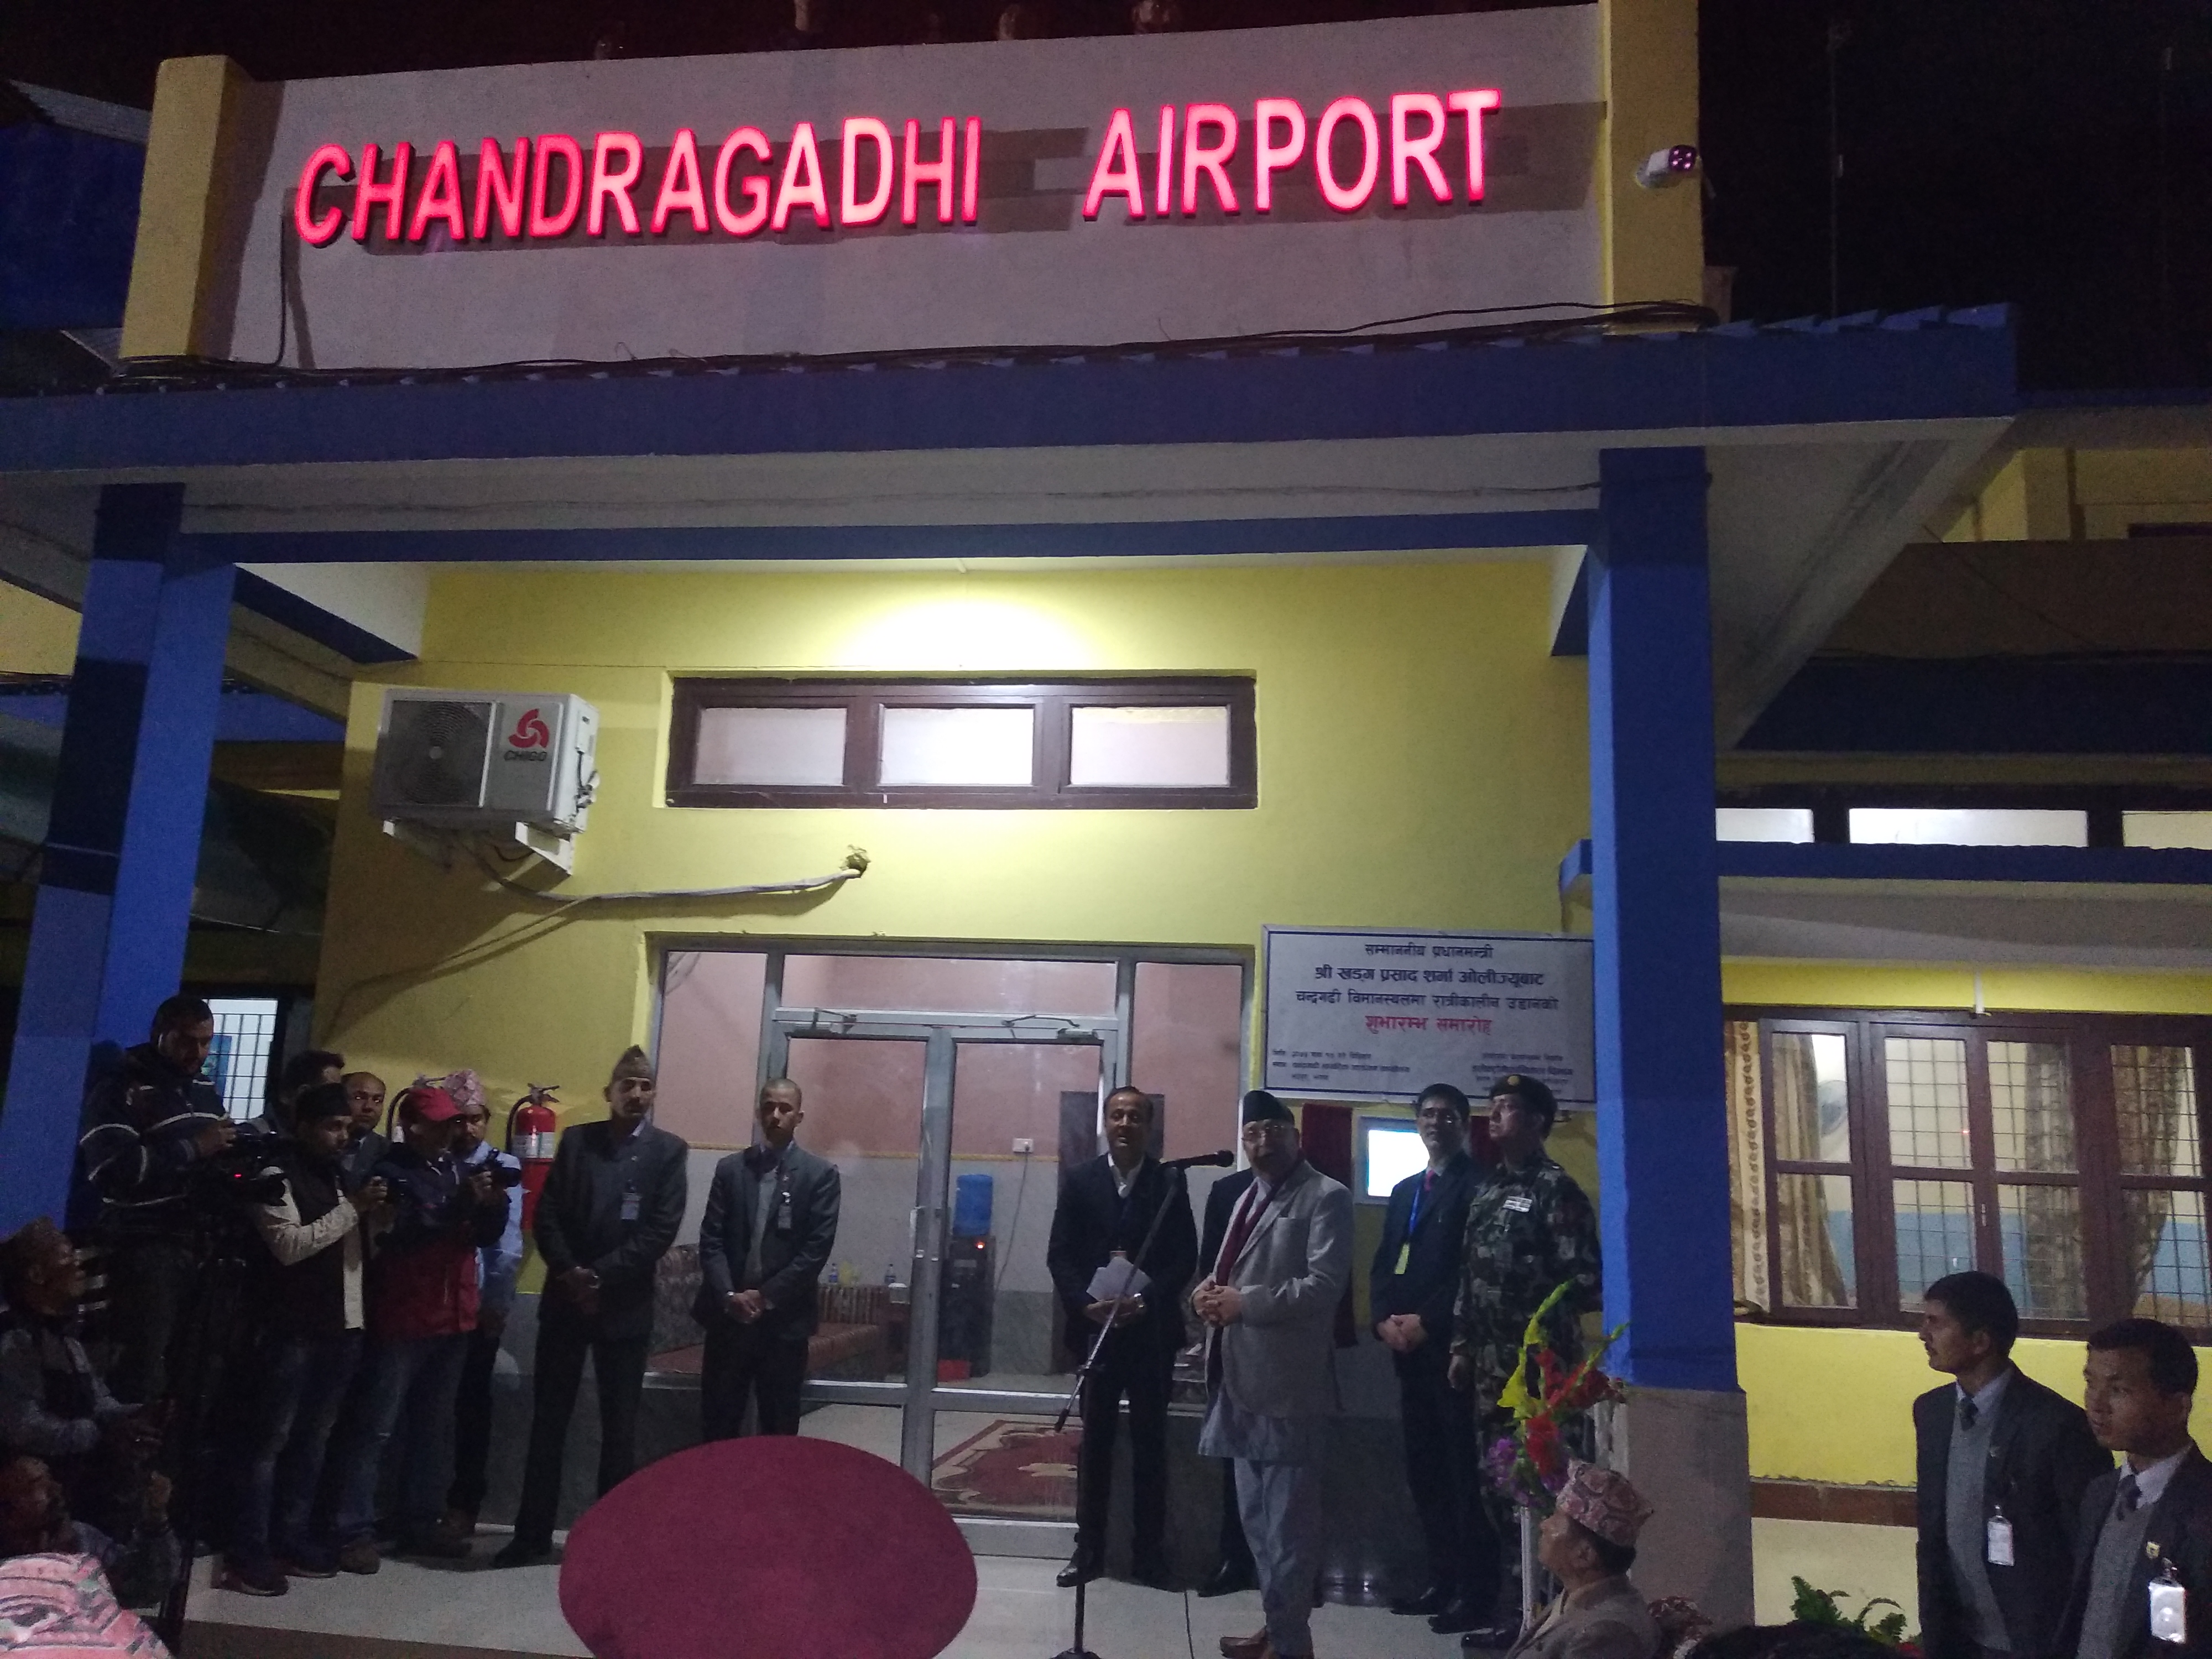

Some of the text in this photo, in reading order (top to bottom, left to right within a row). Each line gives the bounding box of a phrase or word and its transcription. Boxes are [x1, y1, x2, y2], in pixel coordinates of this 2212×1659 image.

[294, 88, 1501, 243] CHANDRAGADHI AIRPORT
[1365, 942, 1494, 958] सम्माननीय प्रधानमन्त्री
[1315, 964, 1332, 979] श्री
[1380, 969, 1419, 982] प्रसाद
[1423, 968, 1452, 983] शर्मा
[1365, 1015, 1492, 1035] शुभारम्भ समारोह
